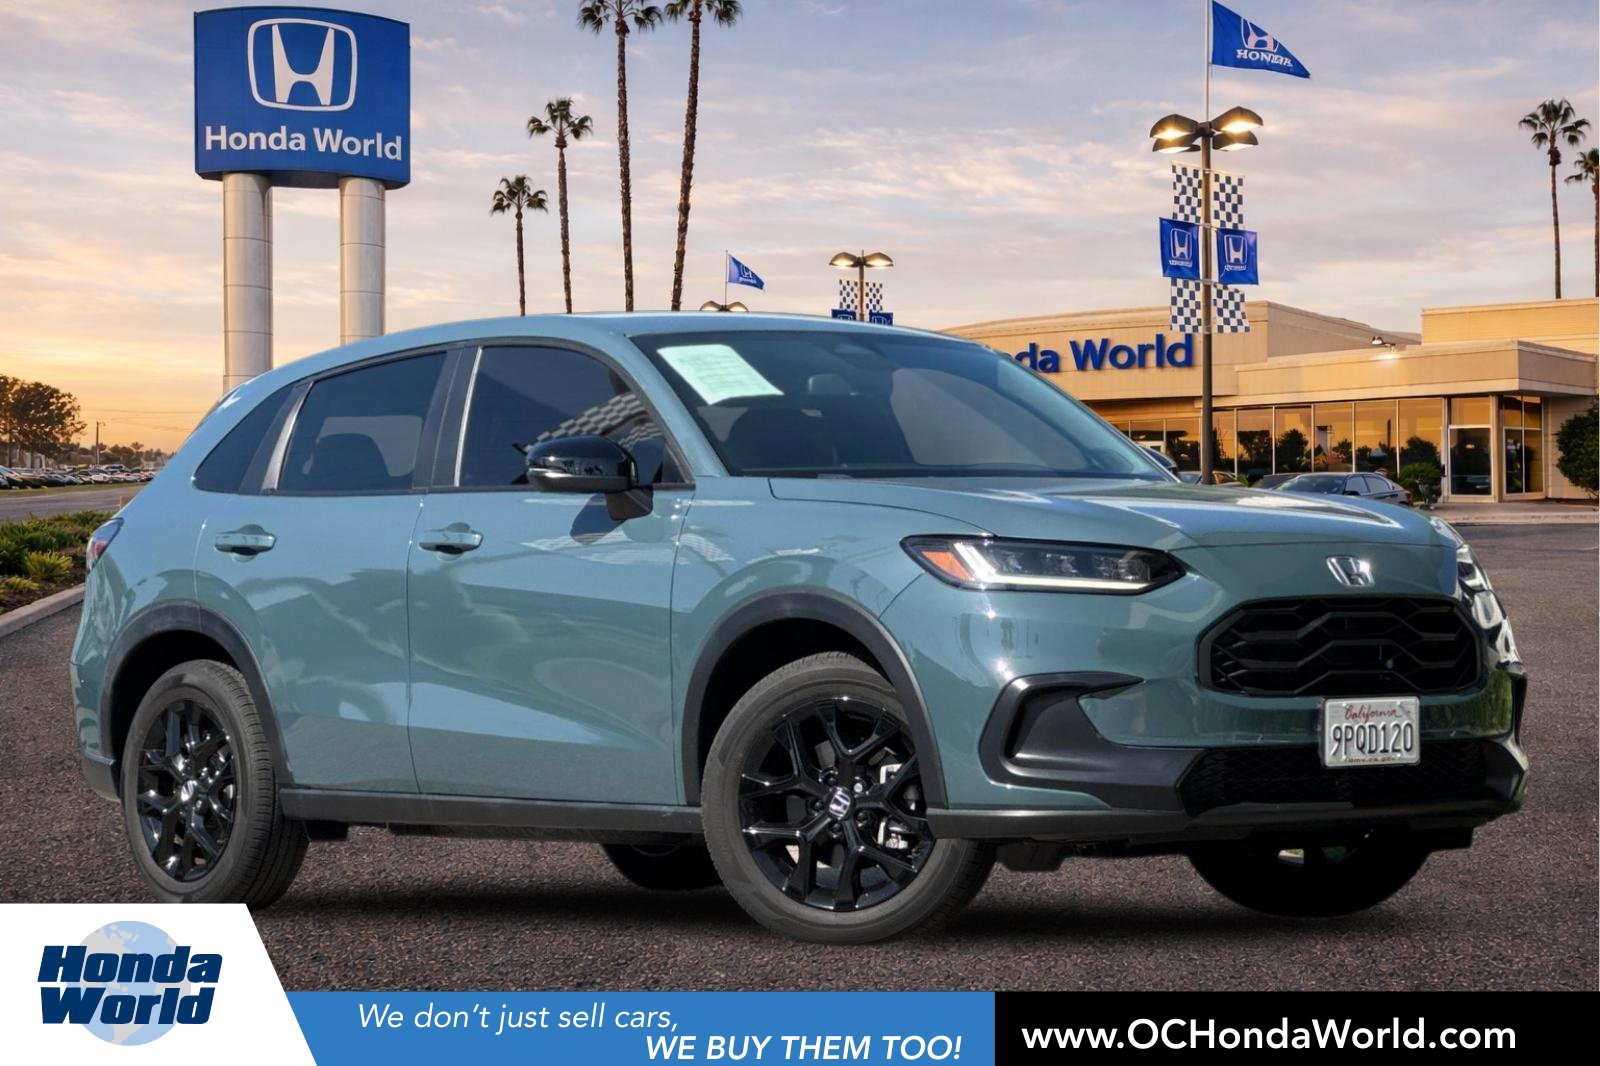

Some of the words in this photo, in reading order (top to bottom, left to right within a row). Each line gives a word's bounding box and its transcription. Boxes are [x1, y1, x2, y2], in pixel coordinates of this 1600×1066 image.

[205, 125, 306, 151] Honda
[313, 127, 402, 160] World
[1070, 333, 1193, 371] World
[1345, 704, 1402, 722] California
[1331, 722, 1414, 756] 9PQD120
